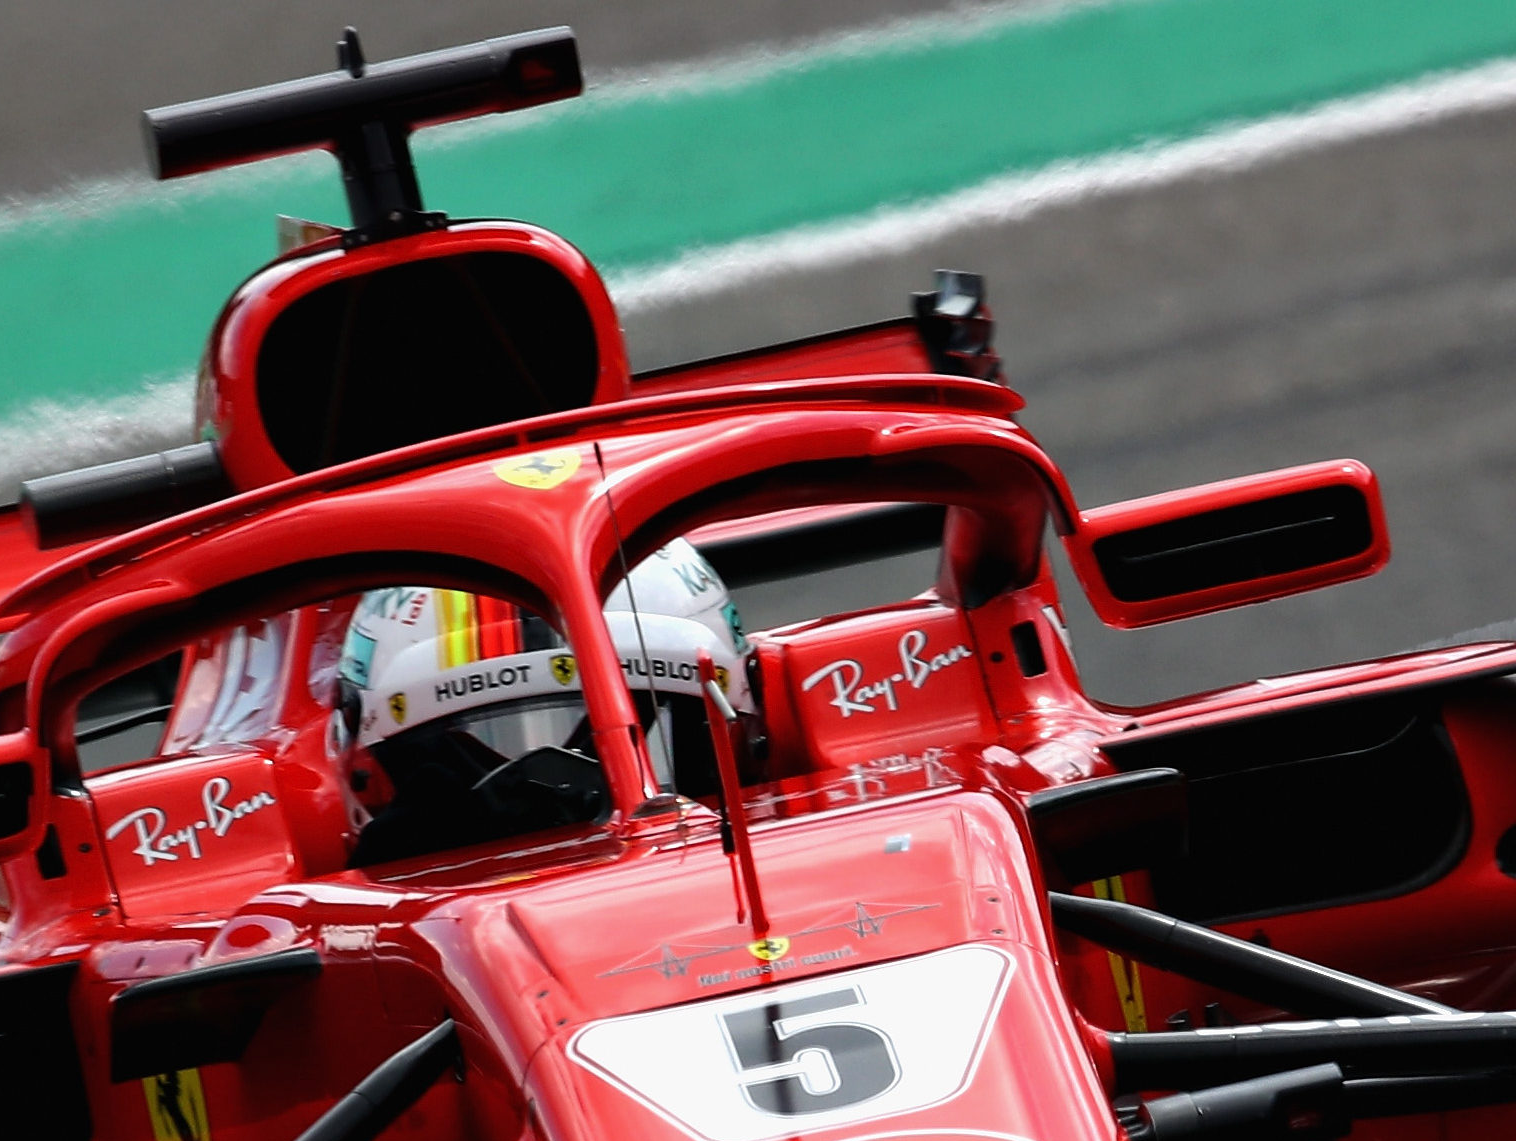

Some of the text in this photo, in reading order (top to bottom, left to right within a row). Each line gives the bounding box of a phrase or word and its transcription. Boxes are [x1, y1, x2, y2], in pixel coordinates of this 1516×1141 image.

[435, 665, 531, 702] HUBLOT
[801, 630, 973, 718] Ray-Ban
[105, 777, 277, 866] Ray-Ban
[717, 985, 902, 1119] 5
